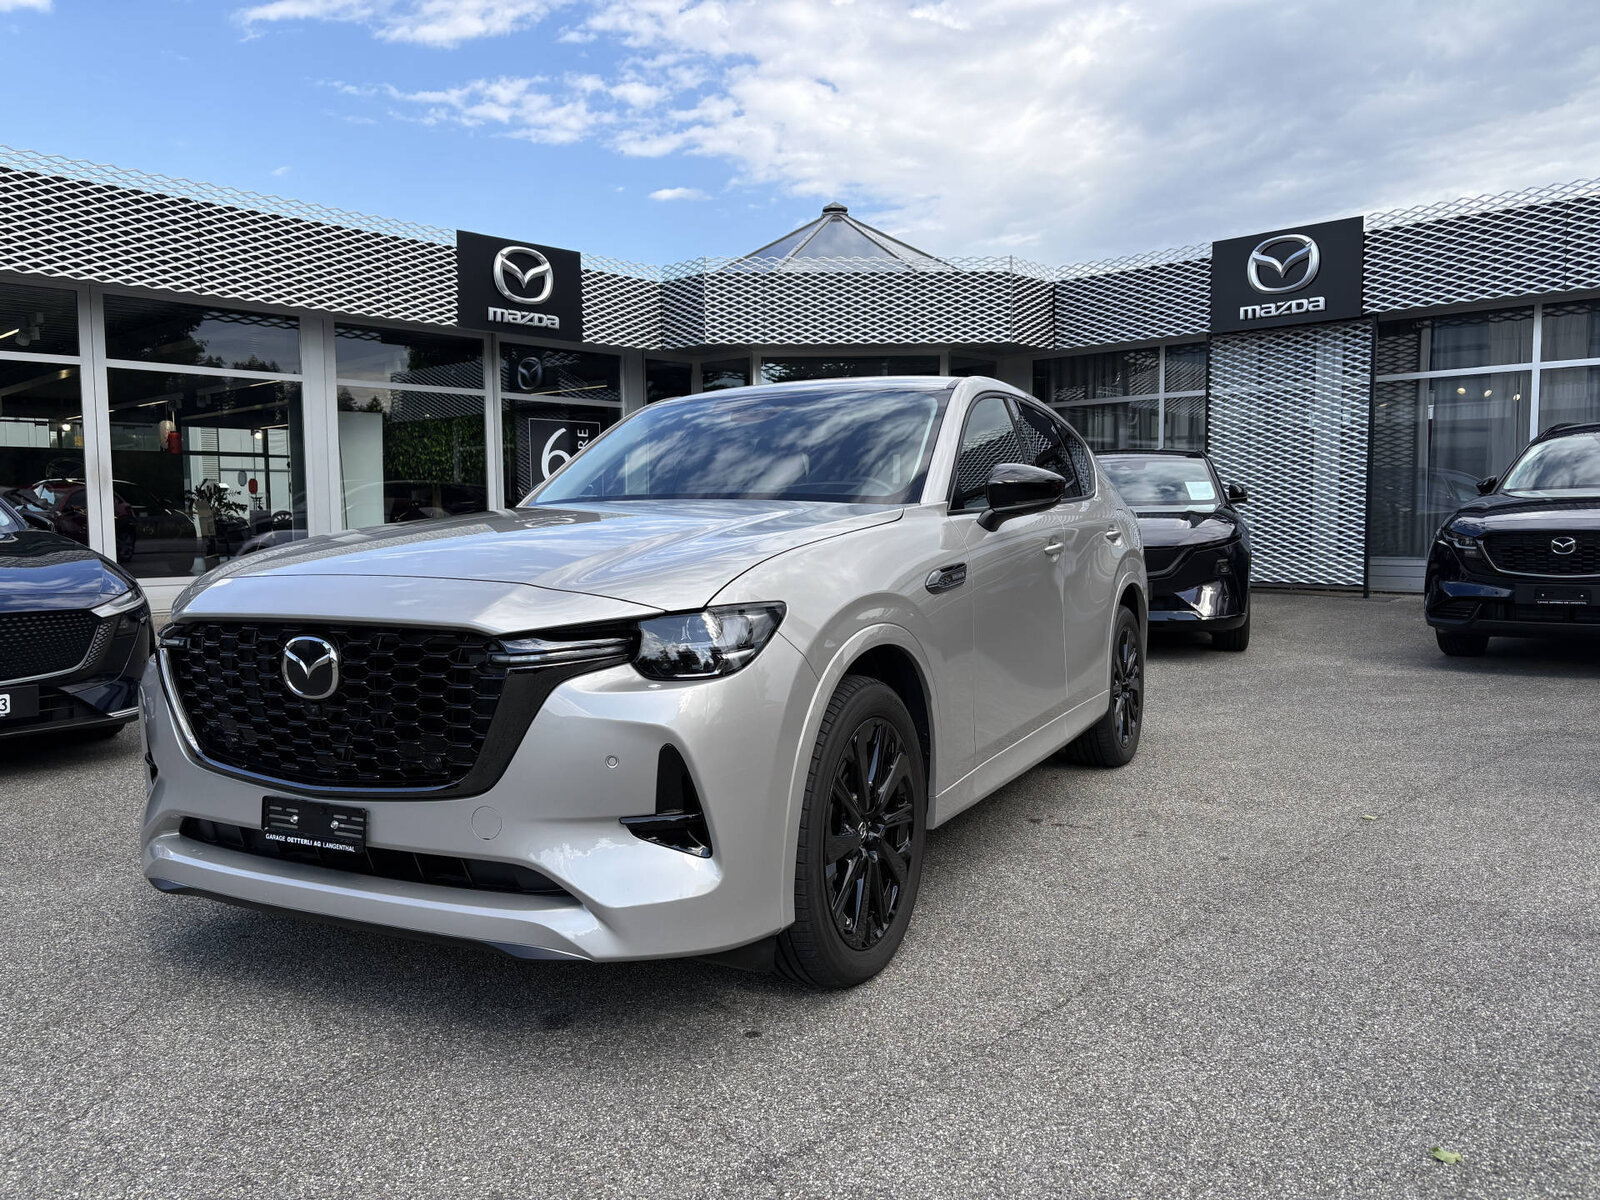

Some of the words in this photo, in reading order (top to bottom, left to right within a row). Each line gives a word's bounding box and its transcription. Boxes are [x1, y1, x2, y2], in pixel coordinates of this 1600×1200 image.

[541, 427, 572, 480] 6
[265, 833, 286, 842] GARAGE
[286, 836, 313, 846] OETTERLI
[322, 842, 356, 853] LANGENTHAL
